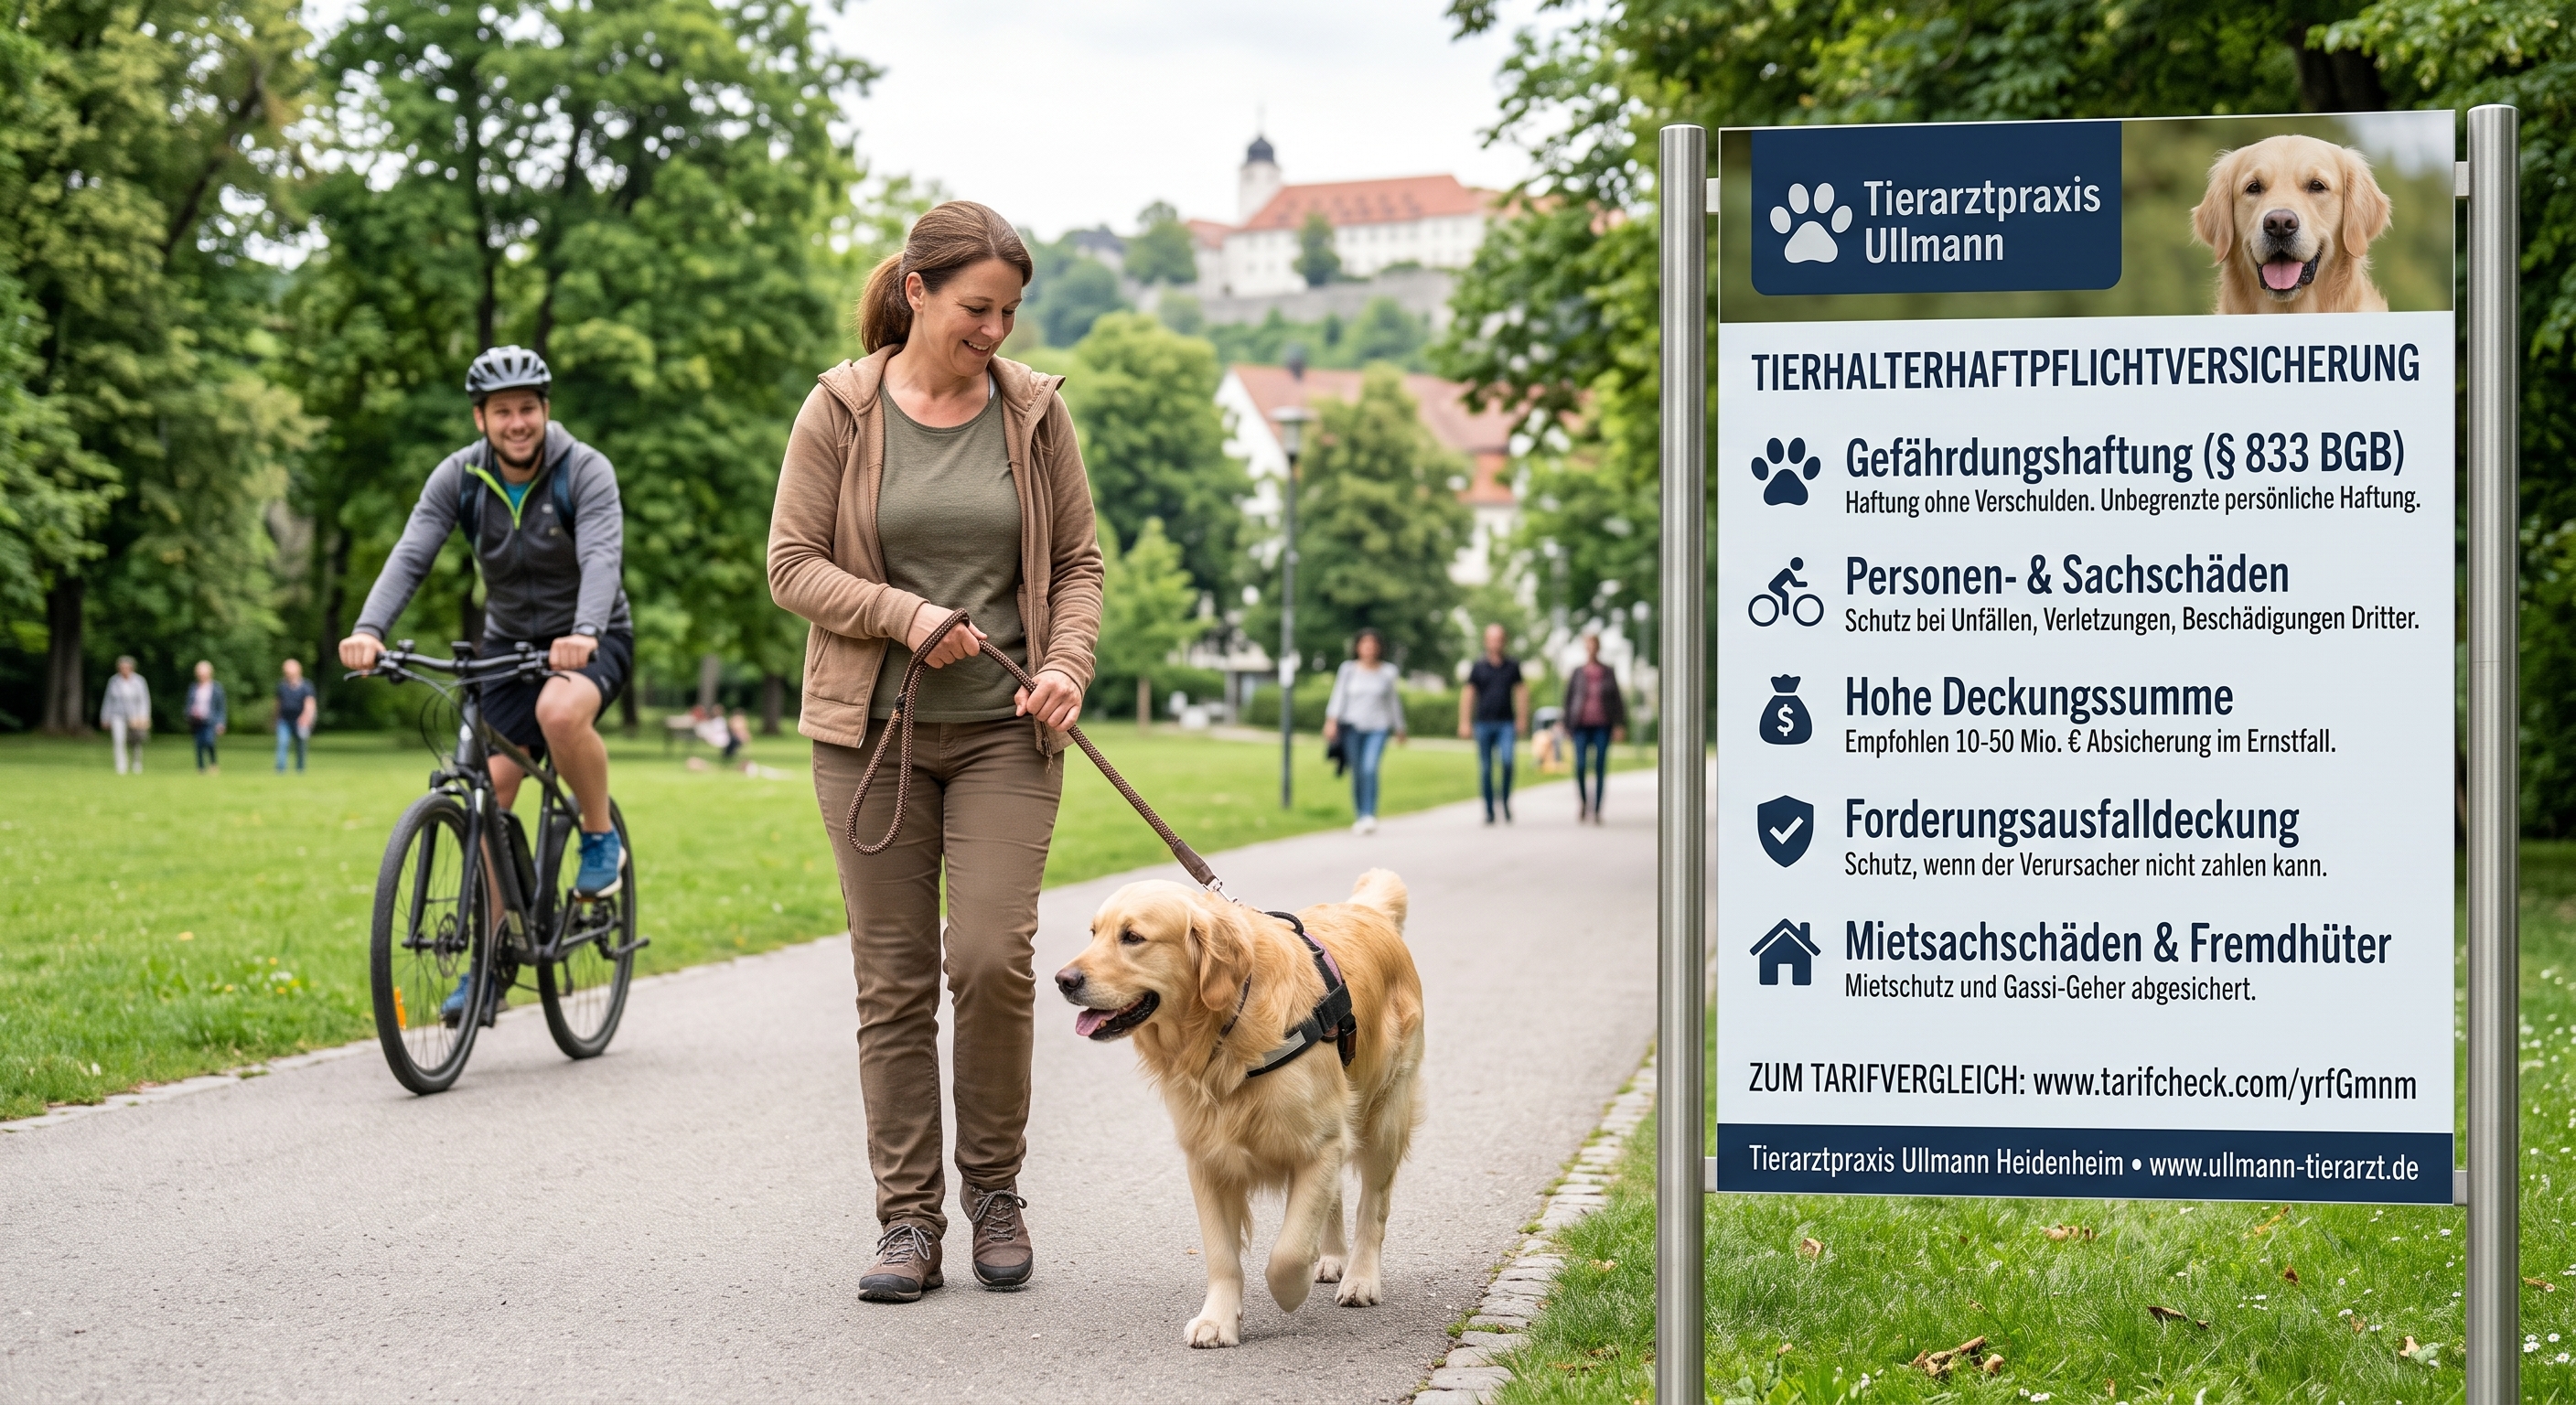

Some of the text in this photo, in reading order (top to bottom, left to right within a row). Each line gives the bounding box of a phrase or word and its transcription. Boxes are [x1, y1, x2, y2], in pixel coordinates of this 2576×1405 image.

[1863, 175, 2101, 223] Tierarztpraxis
[1865, 227, 2003, 263] Ullmann
[1751, 343, 2420, 391] TIERHALTERHAFTPFLICHTVERSICHERUNG
[1846, 429, 2404, 485] Gefährdungshaftung (§ 833 BGB)
[1846, 485, 2420, 519] Haftung ohne Verschulden. Unbegrenzte persönliche Haftung.
[1847, 552, 2289, 595] Personen- & Sachschäden
[1845, 605, 2420, 637] Schutz bei Unfällen, Verletzungen, Beschädigungen Dritter.
[1846, 676, 2234, 725] Hohe Deckungssumme
[1845, 727, 2336, 759] Empfohlen 10-50 Mio. € Absicherung im Ernstfall.
[1846, 798, 2300, 849] Forderungsausfalldeckung
[1844, 851, 2327, 880] Schutz, wenn der Verursacher nicht zahlen kann.
[1846, 920, 2392, 964] Mietsachschäden & Fremdhüter
[1845, 972, 2256, 1006] Mietschutz und Gassi-Geher abgesichert.
[1748, 1062, 2417, 1106] ZUM TARIFVERGLEICH: www.tarifcheck.com/yrfGmnm
[1748, 1144, 2419, 1181] Tierarztpraxis Ullmann Heidenheim www.ullmann-tierarzt.de
